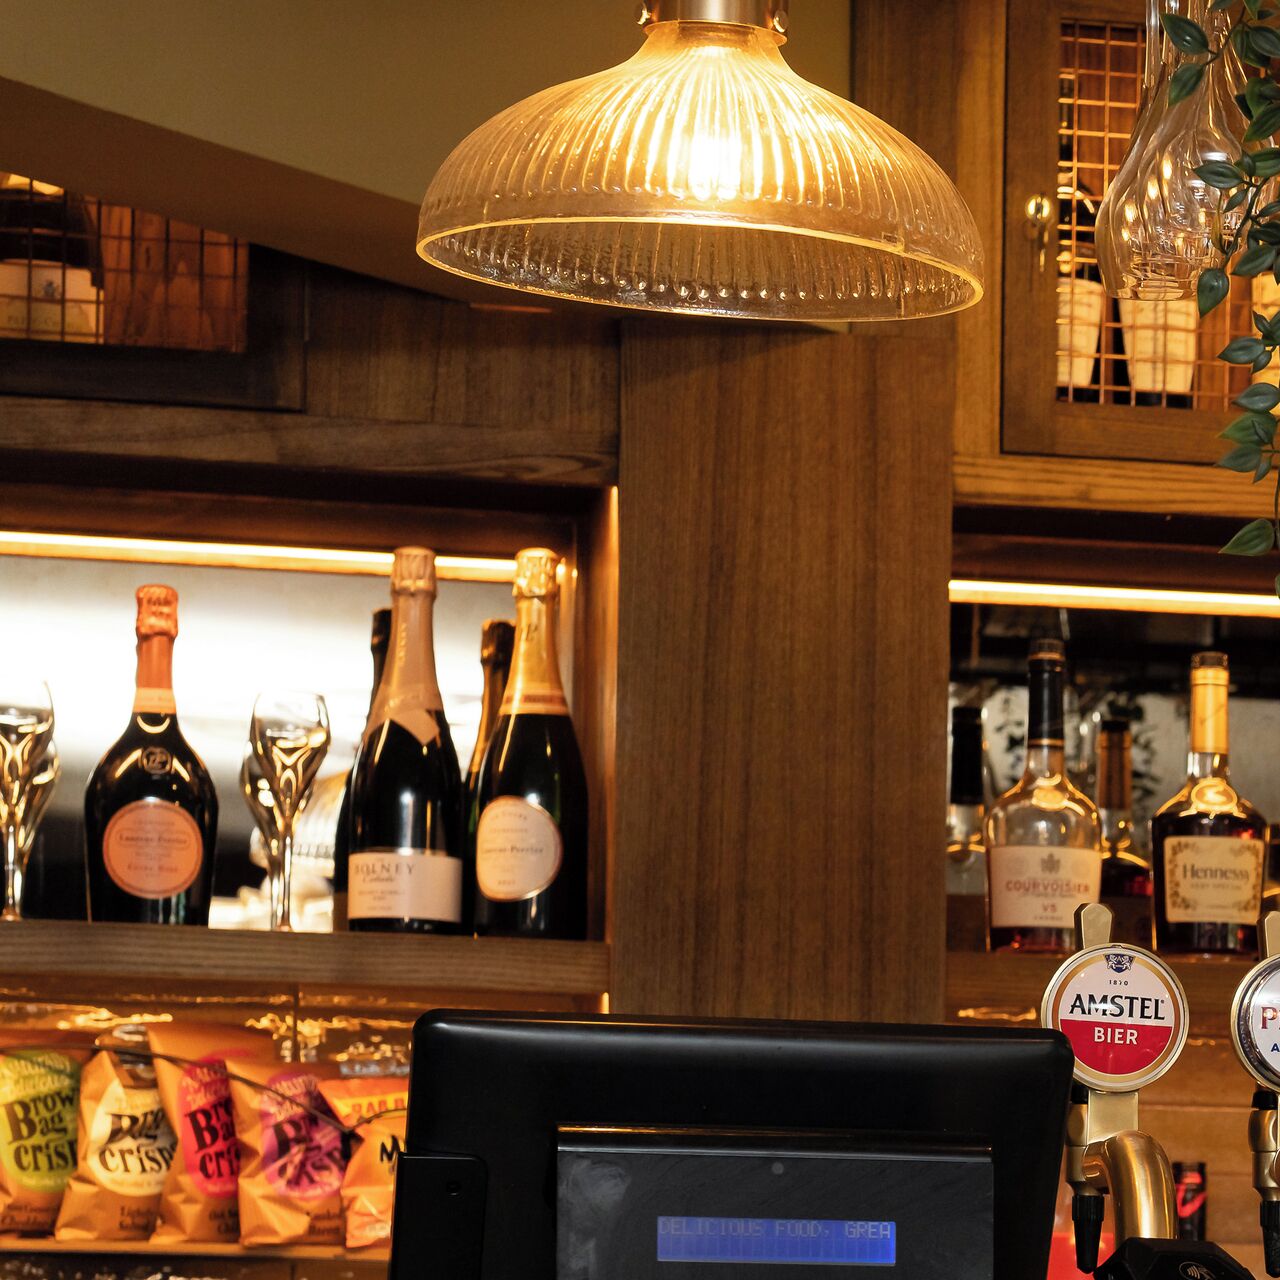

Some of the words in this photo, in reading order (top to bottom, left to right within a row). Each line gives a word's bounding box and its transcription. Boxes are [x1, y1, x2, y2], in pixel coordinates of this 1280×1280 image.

[1183, 864, 1249, 884] Hennessy
[1006, 880, 1090, 893] COURVOISIER
[1069, 993, 1166, 1021] AMSTEL
[1094, 1027, 1138, 1045] BIER
[659, 1217, 764, 1237] DELICIOUS
[845, 1221, 891, 1239] GREA
